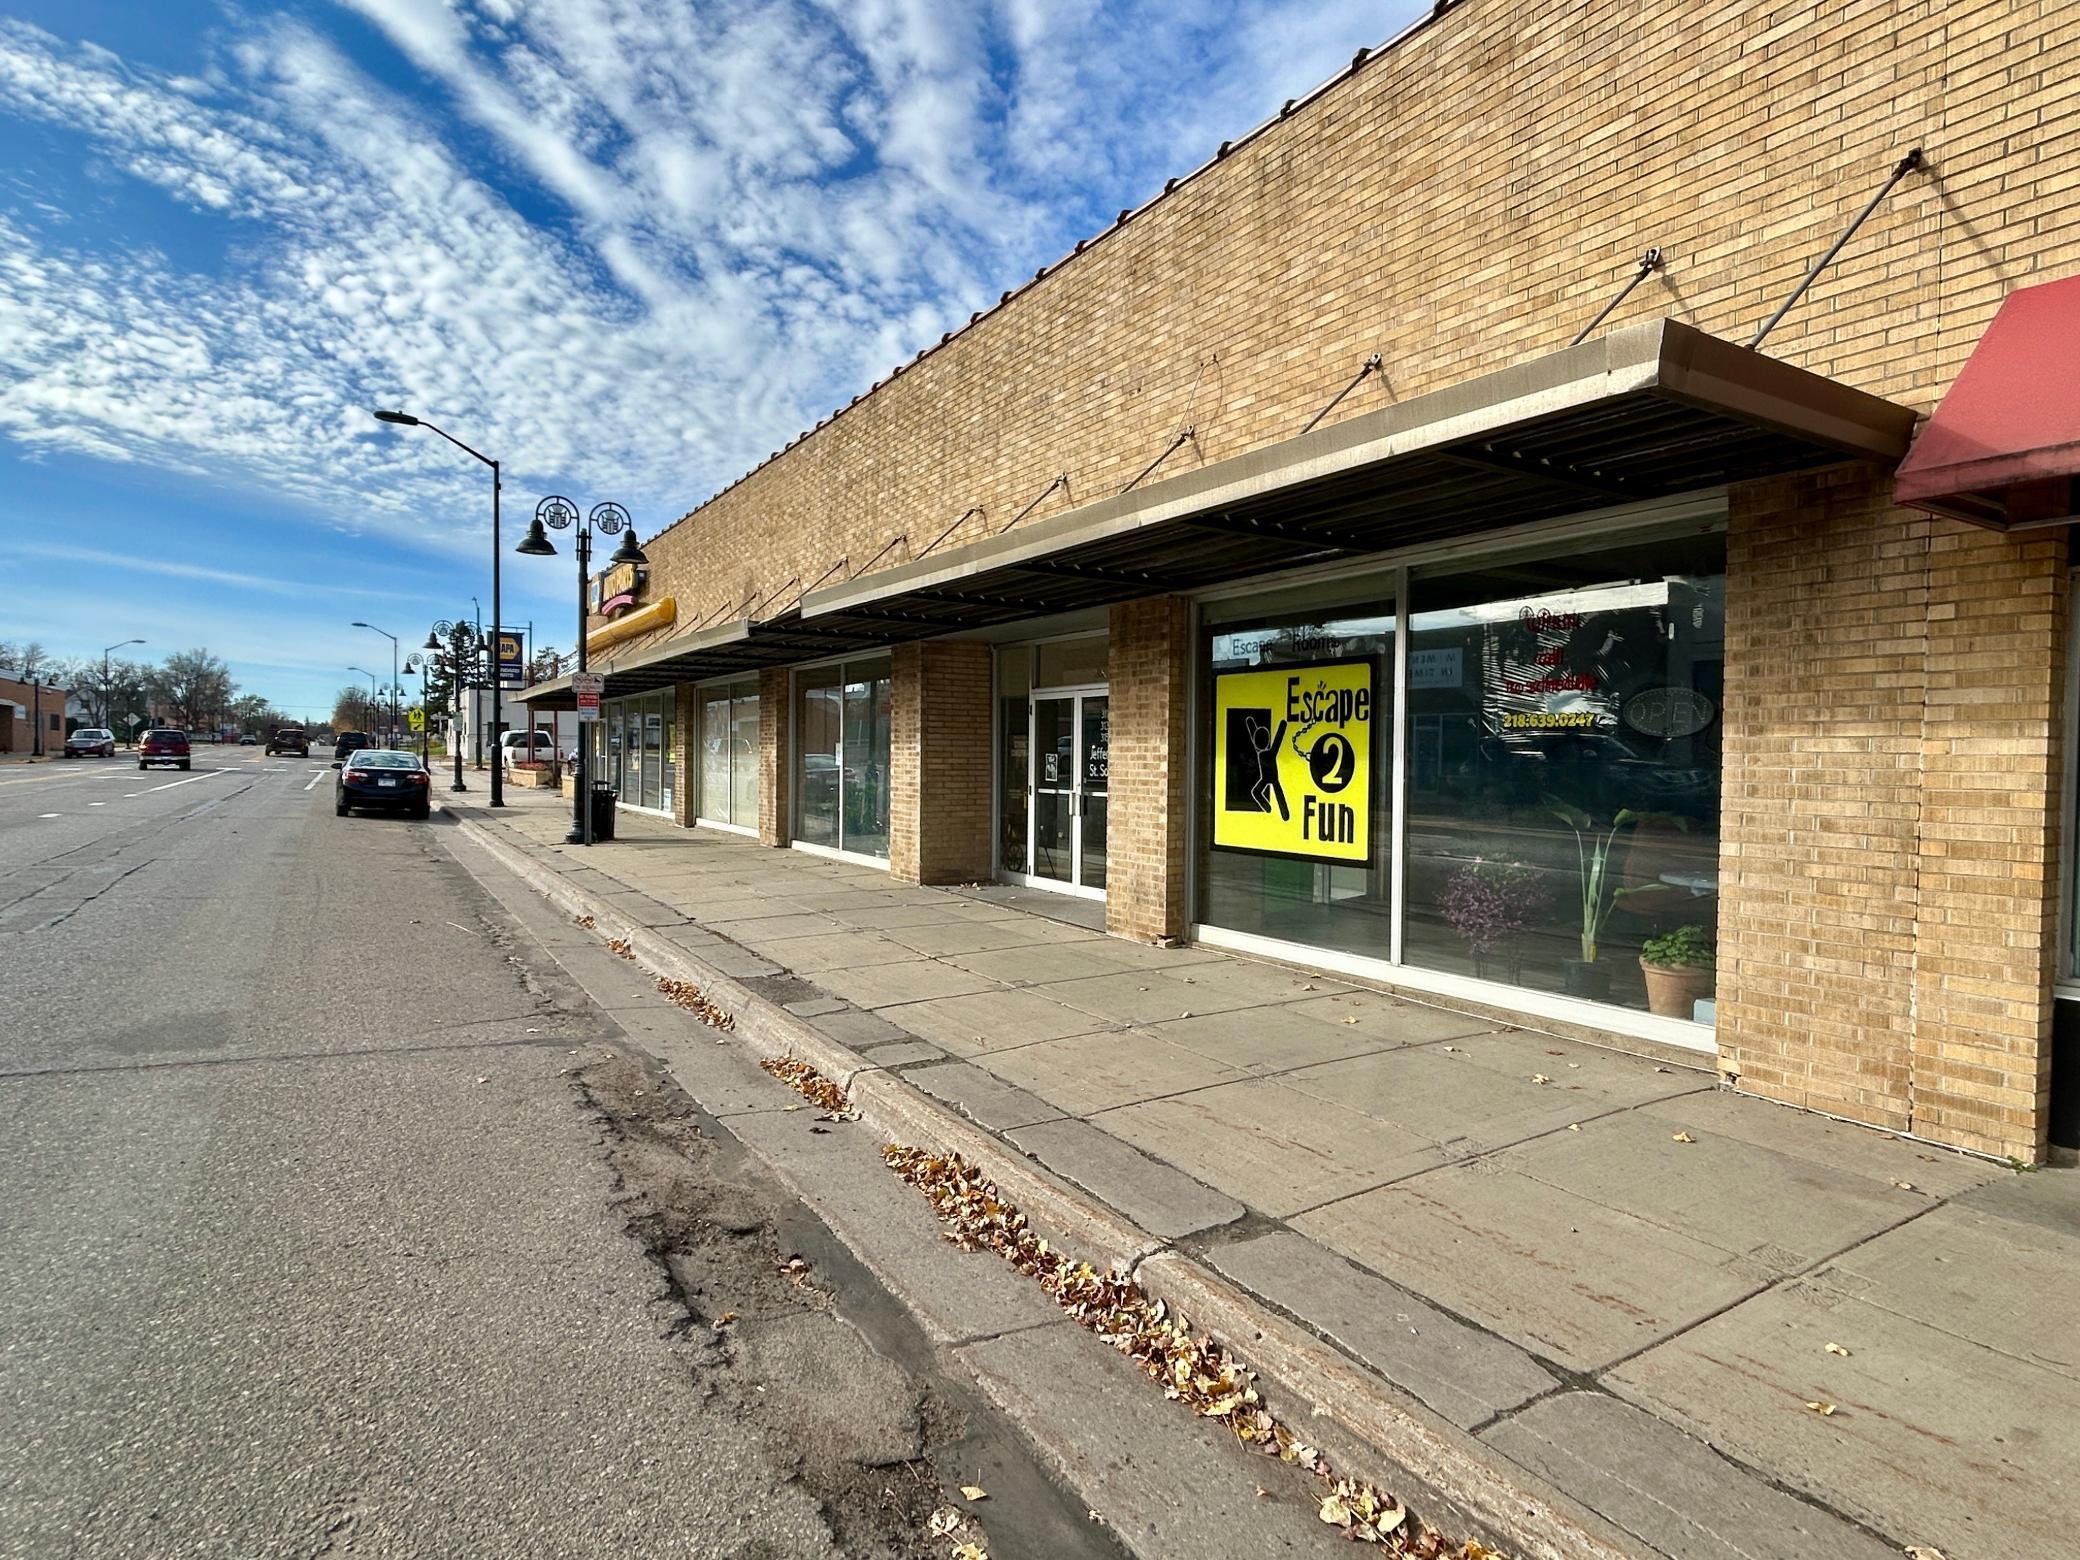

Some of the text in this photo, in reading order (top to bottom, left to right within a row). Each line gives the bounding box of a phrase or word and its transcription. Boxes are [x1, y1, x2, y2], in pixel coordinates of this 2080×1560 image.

[1232, 638, 1273, 656] Escape
[1287, 676, 1370, 728] Escape
[1631, 701, 1707, 726] OPEN
[1321, 736, 1343, 784] 2
[1303, 795, 1354, 844] Fun
